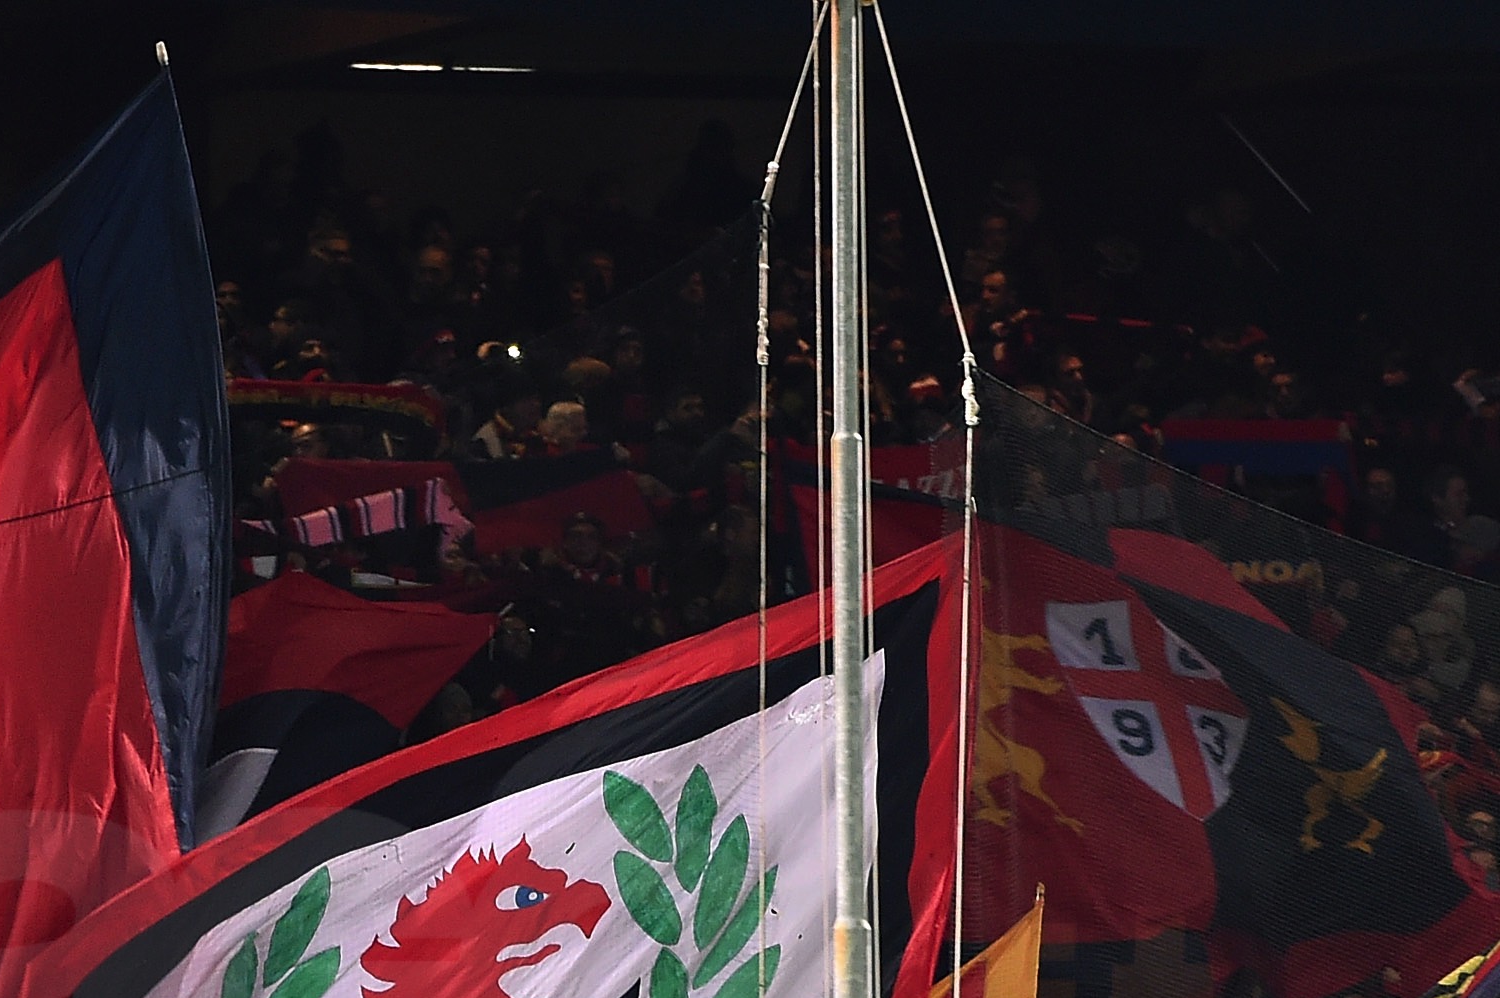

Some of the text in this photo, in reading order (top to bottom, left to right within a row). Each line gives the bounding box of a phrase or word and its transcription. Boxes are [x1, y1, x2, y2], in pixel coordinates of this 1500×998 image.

[1084, 617, 1126, 666] 1
[1112, 707, 1228, 766] 9 3
